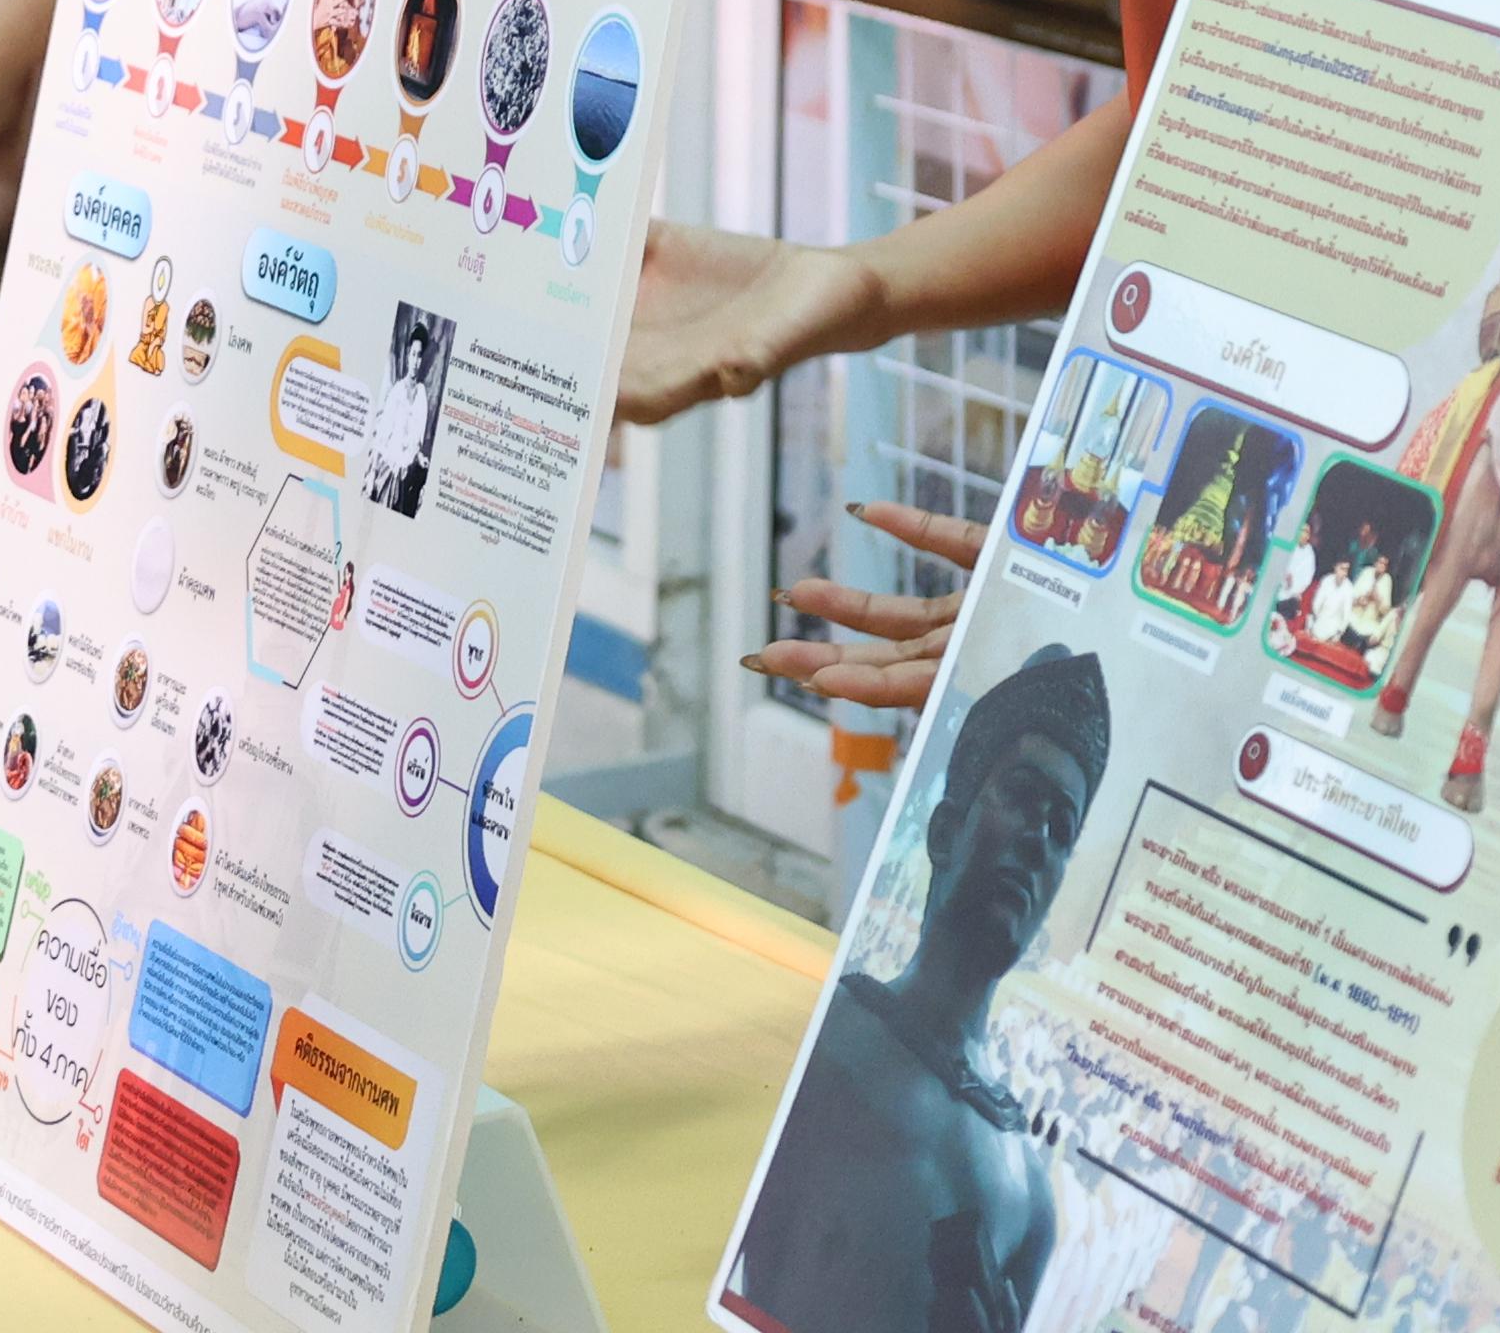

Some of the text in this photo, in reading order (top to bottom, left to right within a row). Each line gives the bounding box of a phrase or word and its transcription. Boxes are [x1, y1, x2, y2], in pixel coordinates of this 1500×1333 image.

[73, 185, 142, 241] องค์บุคคล
[258, 245, 319, 313] องค์วัตถุ
[36, 929, 108, 988] ความเชื่อ
[47, 989, 78, 1027] ของ
[12, 1010, 89, 1093] ทั้ง 4 ภาค
[294, 1032, 400, 1118] คติธรรมจากงานศพ
